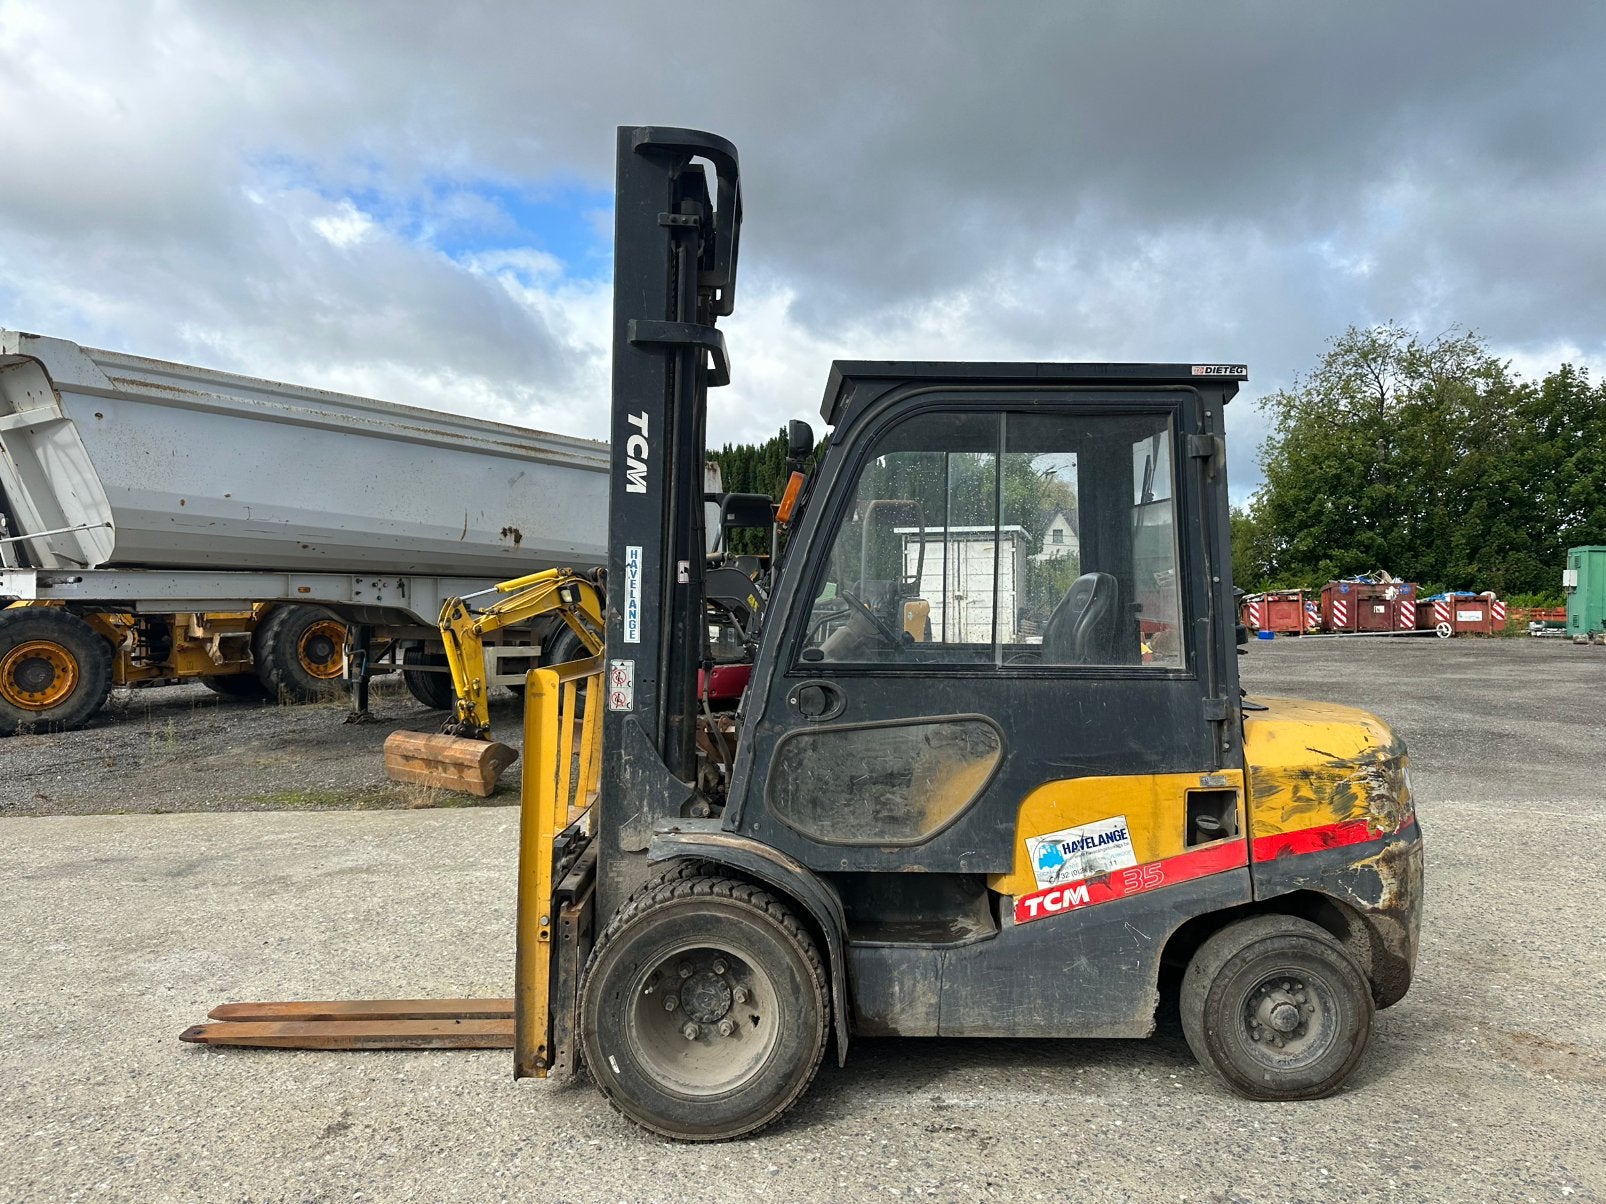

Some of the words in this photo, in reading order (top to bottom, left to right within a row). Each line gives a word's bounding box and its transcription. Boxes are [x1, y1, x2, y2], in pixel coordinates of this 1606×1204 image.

[626, 411, 649, 494] TCM
[628, 549, 638, 640] HAVELANGE
[1061, 828, 1128, 855] HAVELANGE
[1123, 863, 1165, 895] 35
[1024, 884, 1091, 917] TCM
